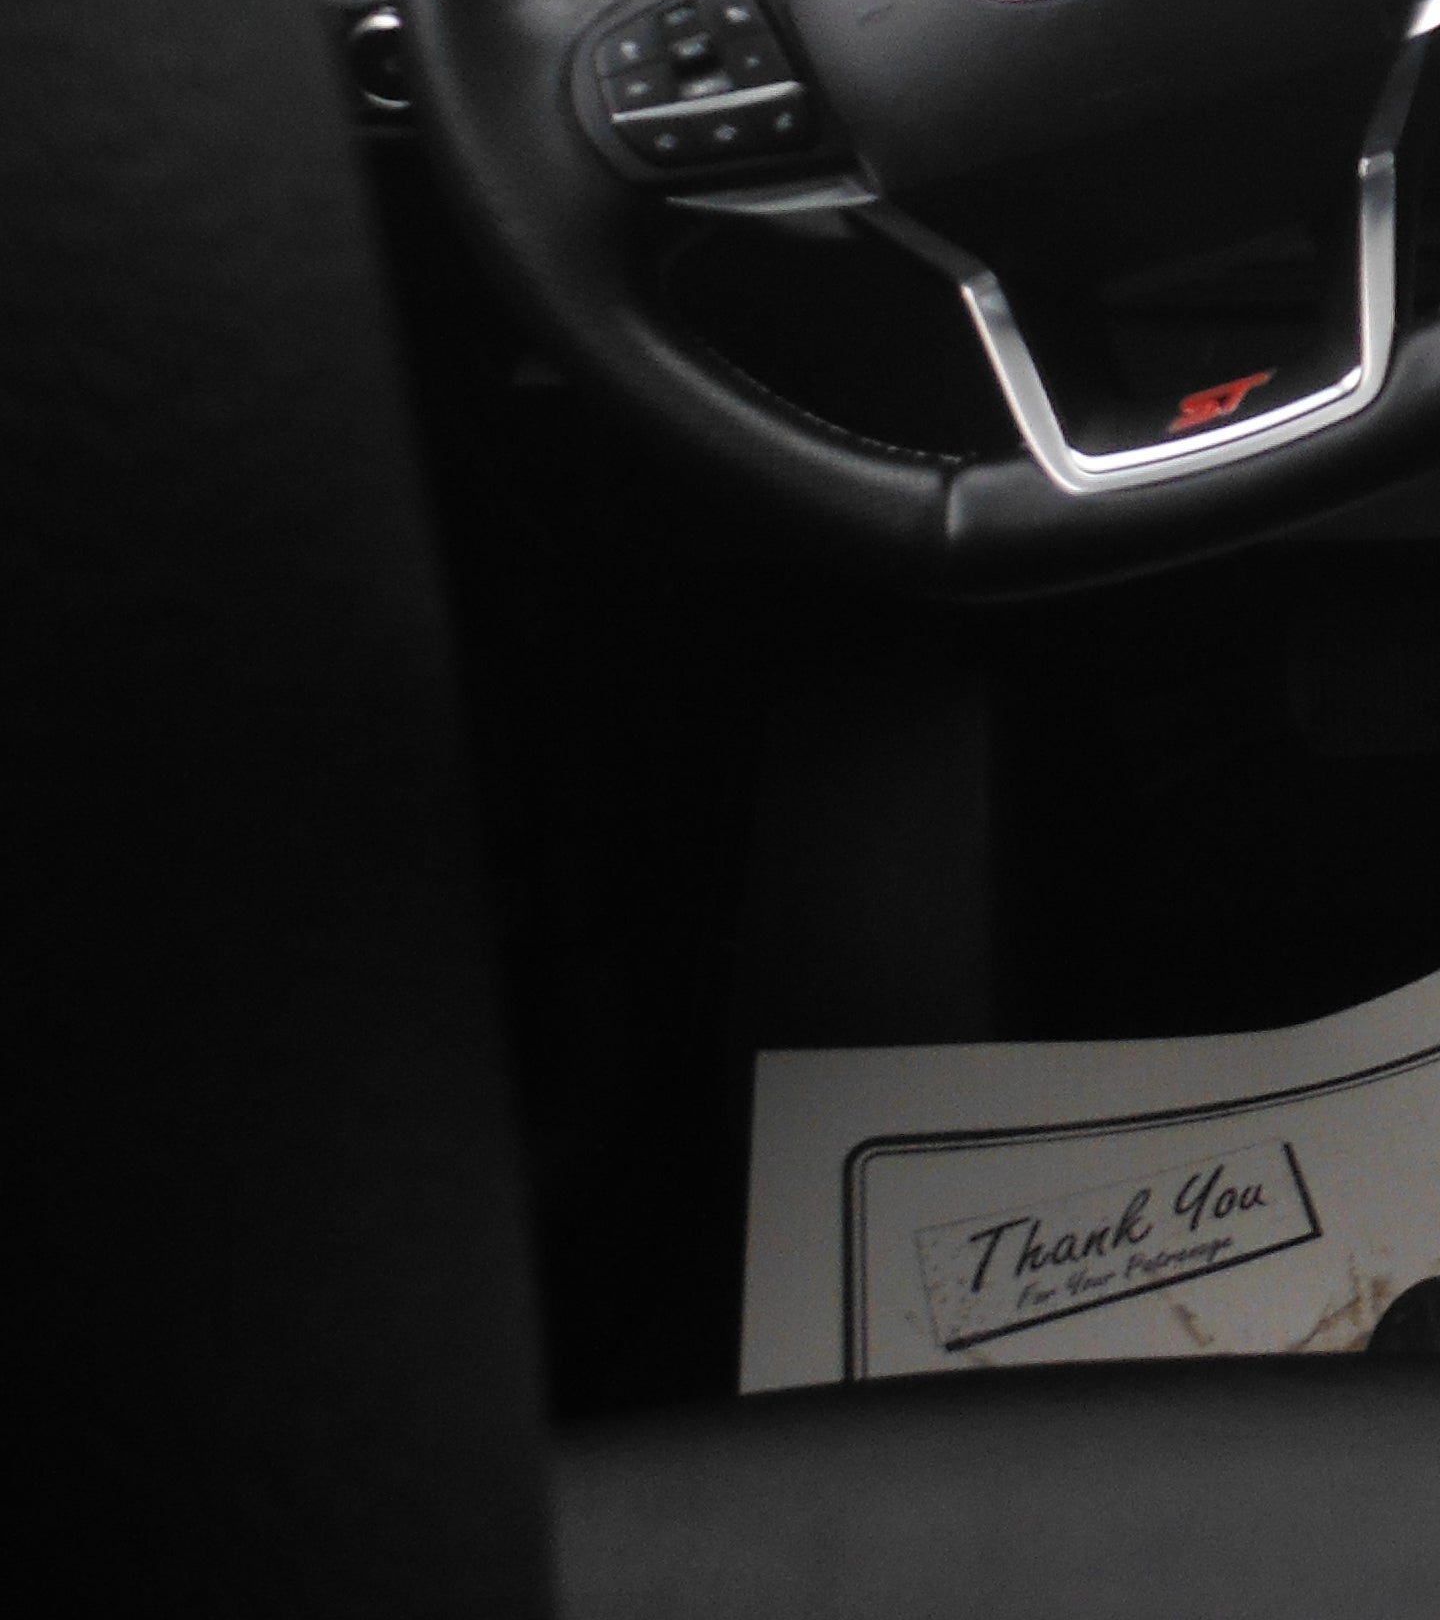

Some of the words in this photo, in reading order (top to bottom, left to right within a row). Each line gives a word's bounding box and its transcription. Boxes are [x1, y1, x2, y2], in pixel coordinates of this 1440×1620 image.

[1168, 370, 1272, 433] ST
[969, 1187, 1153, 1293] Thank
[1173, 1163, 1267, 1231] You
[1016, 1280, 1057, 1310] For
[1064, 1267, 1117, 1297] Your
